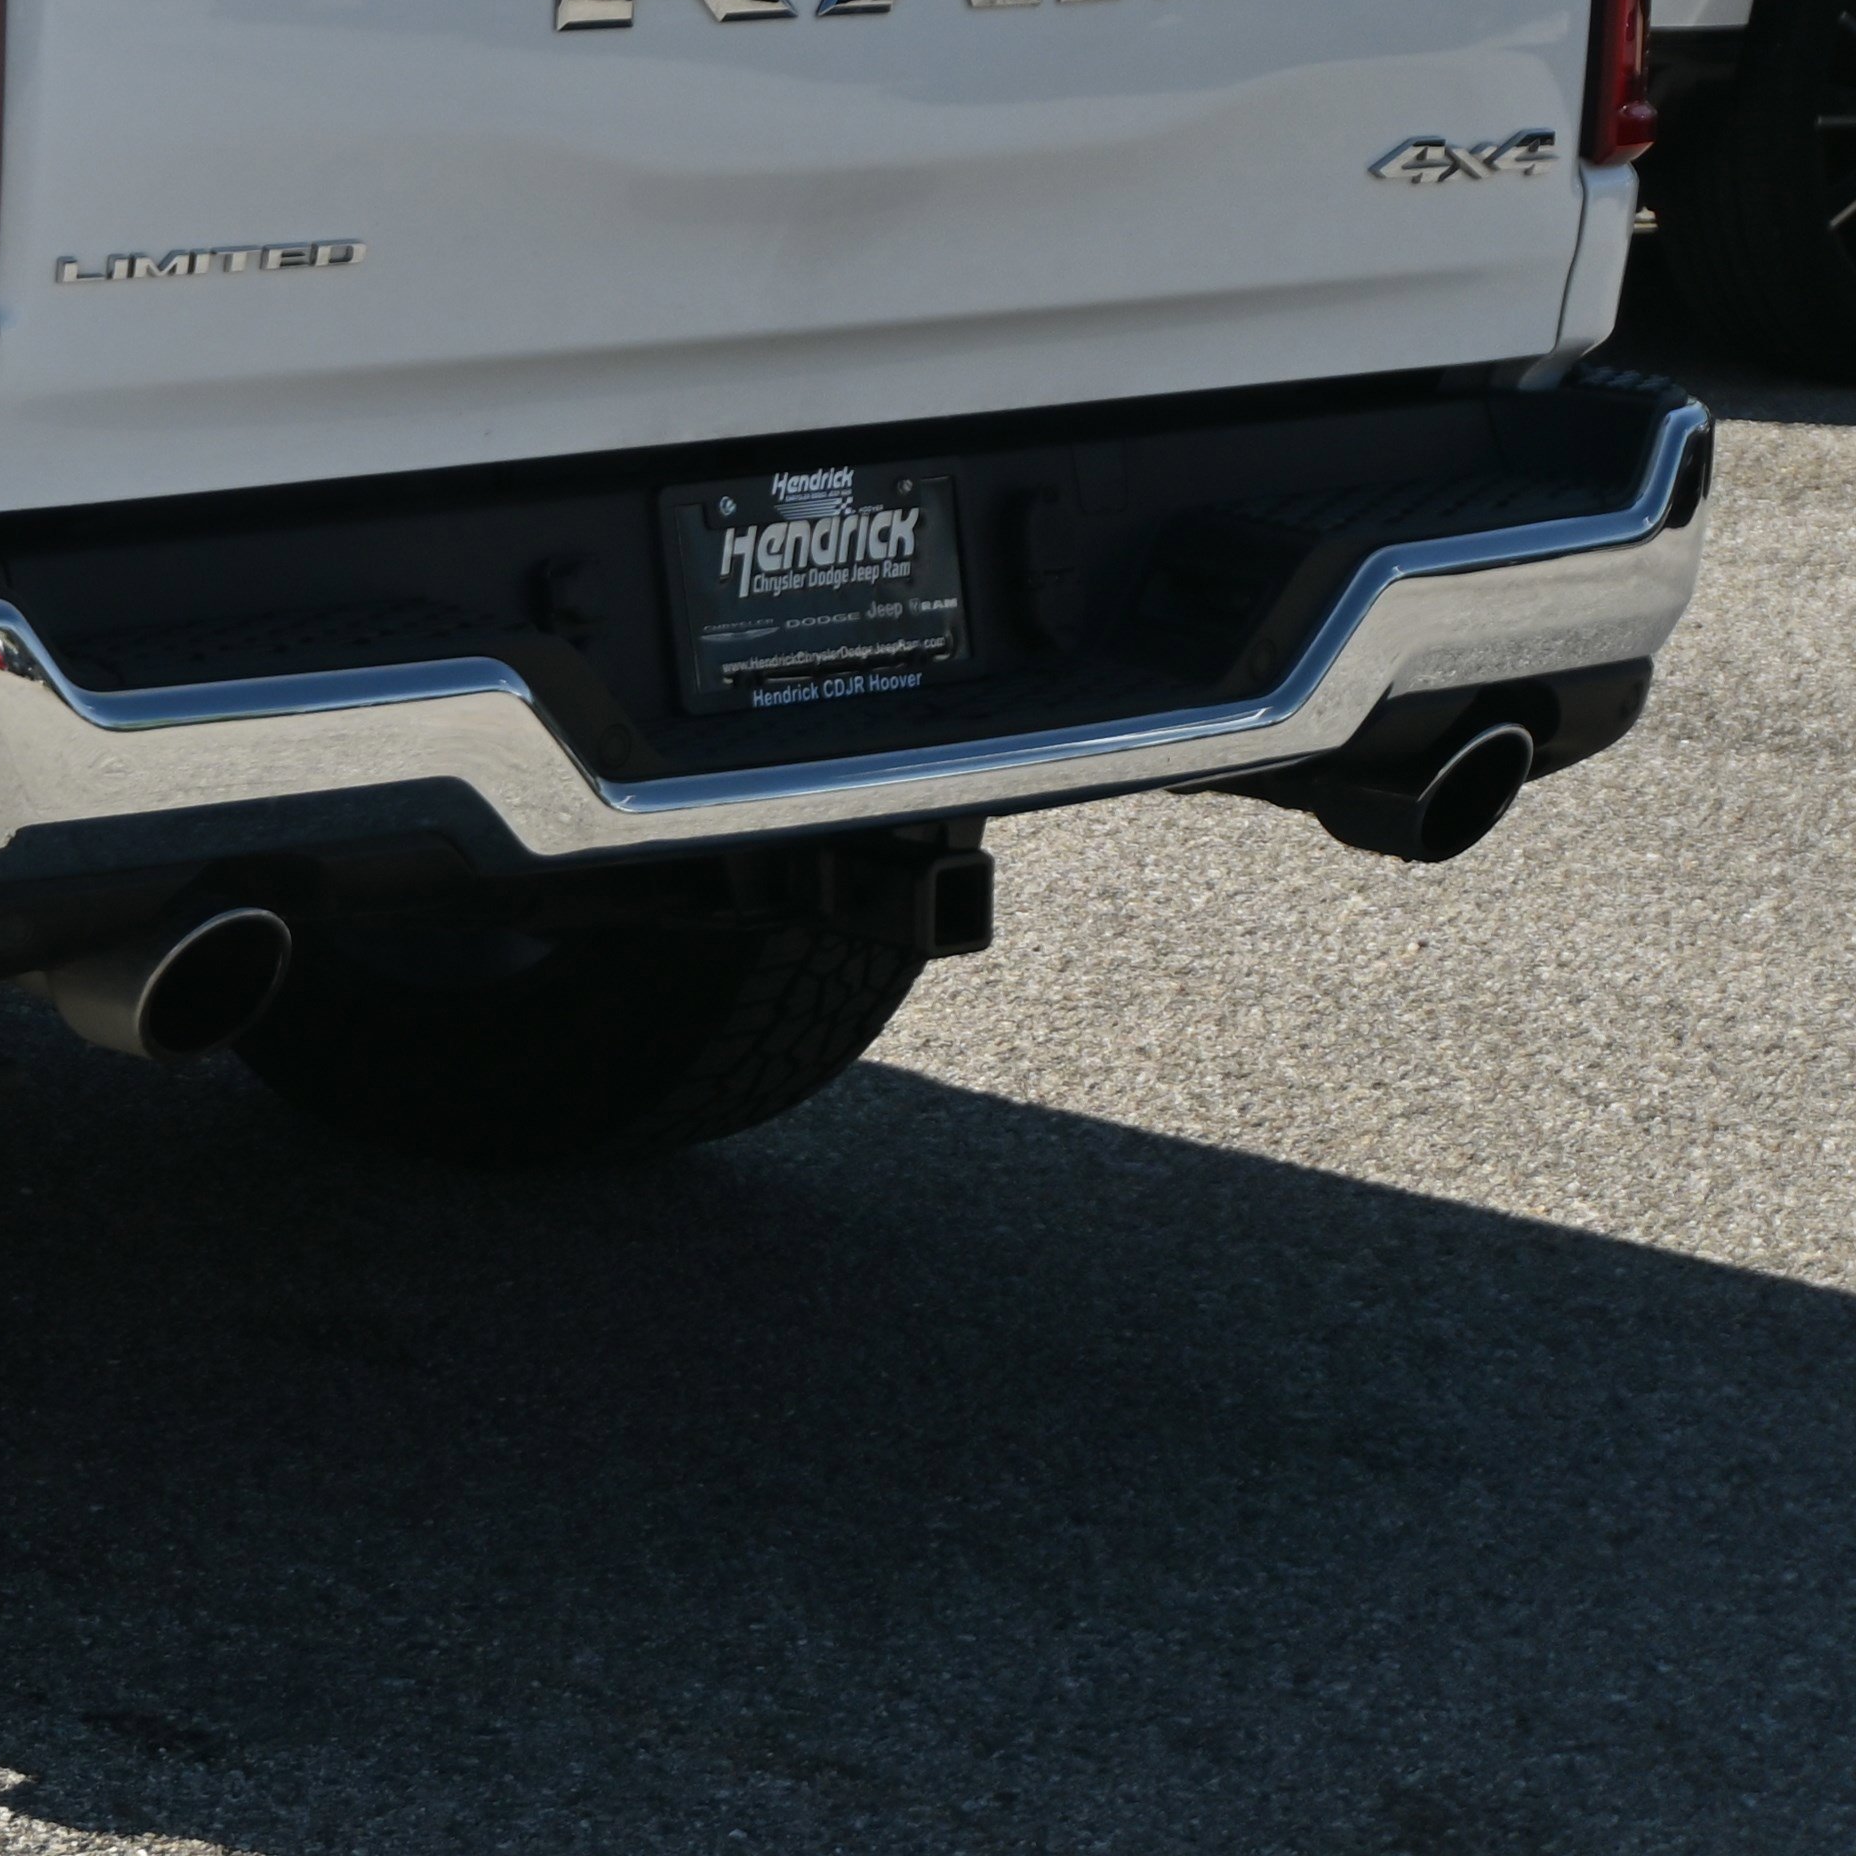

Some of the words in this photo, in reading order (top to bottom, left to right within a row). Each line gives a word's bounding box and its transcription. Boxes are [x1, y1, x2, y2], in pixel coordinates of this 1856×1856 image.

[56, 238, 367, 283] LIMITED
[772, 466, 855, 500] Hendrick
[720, 507, 920, 597] Hendrick
[753, 569, 806, 596] Chrysler
[809, 565, 849, 590] Dodge
[851, 562, 880, 584] Jeep
[884, 559, 911, 579] Ram
[786, 612, 861, 629] DODGE
[866, 600, 903, 620] Jeep
[921, 598, 958, 611] RAM
[753, 684, 819, 708] Hendrick
[823, 676, 866, 698] CDJR
[869, 672, 922, 692] Hoover
